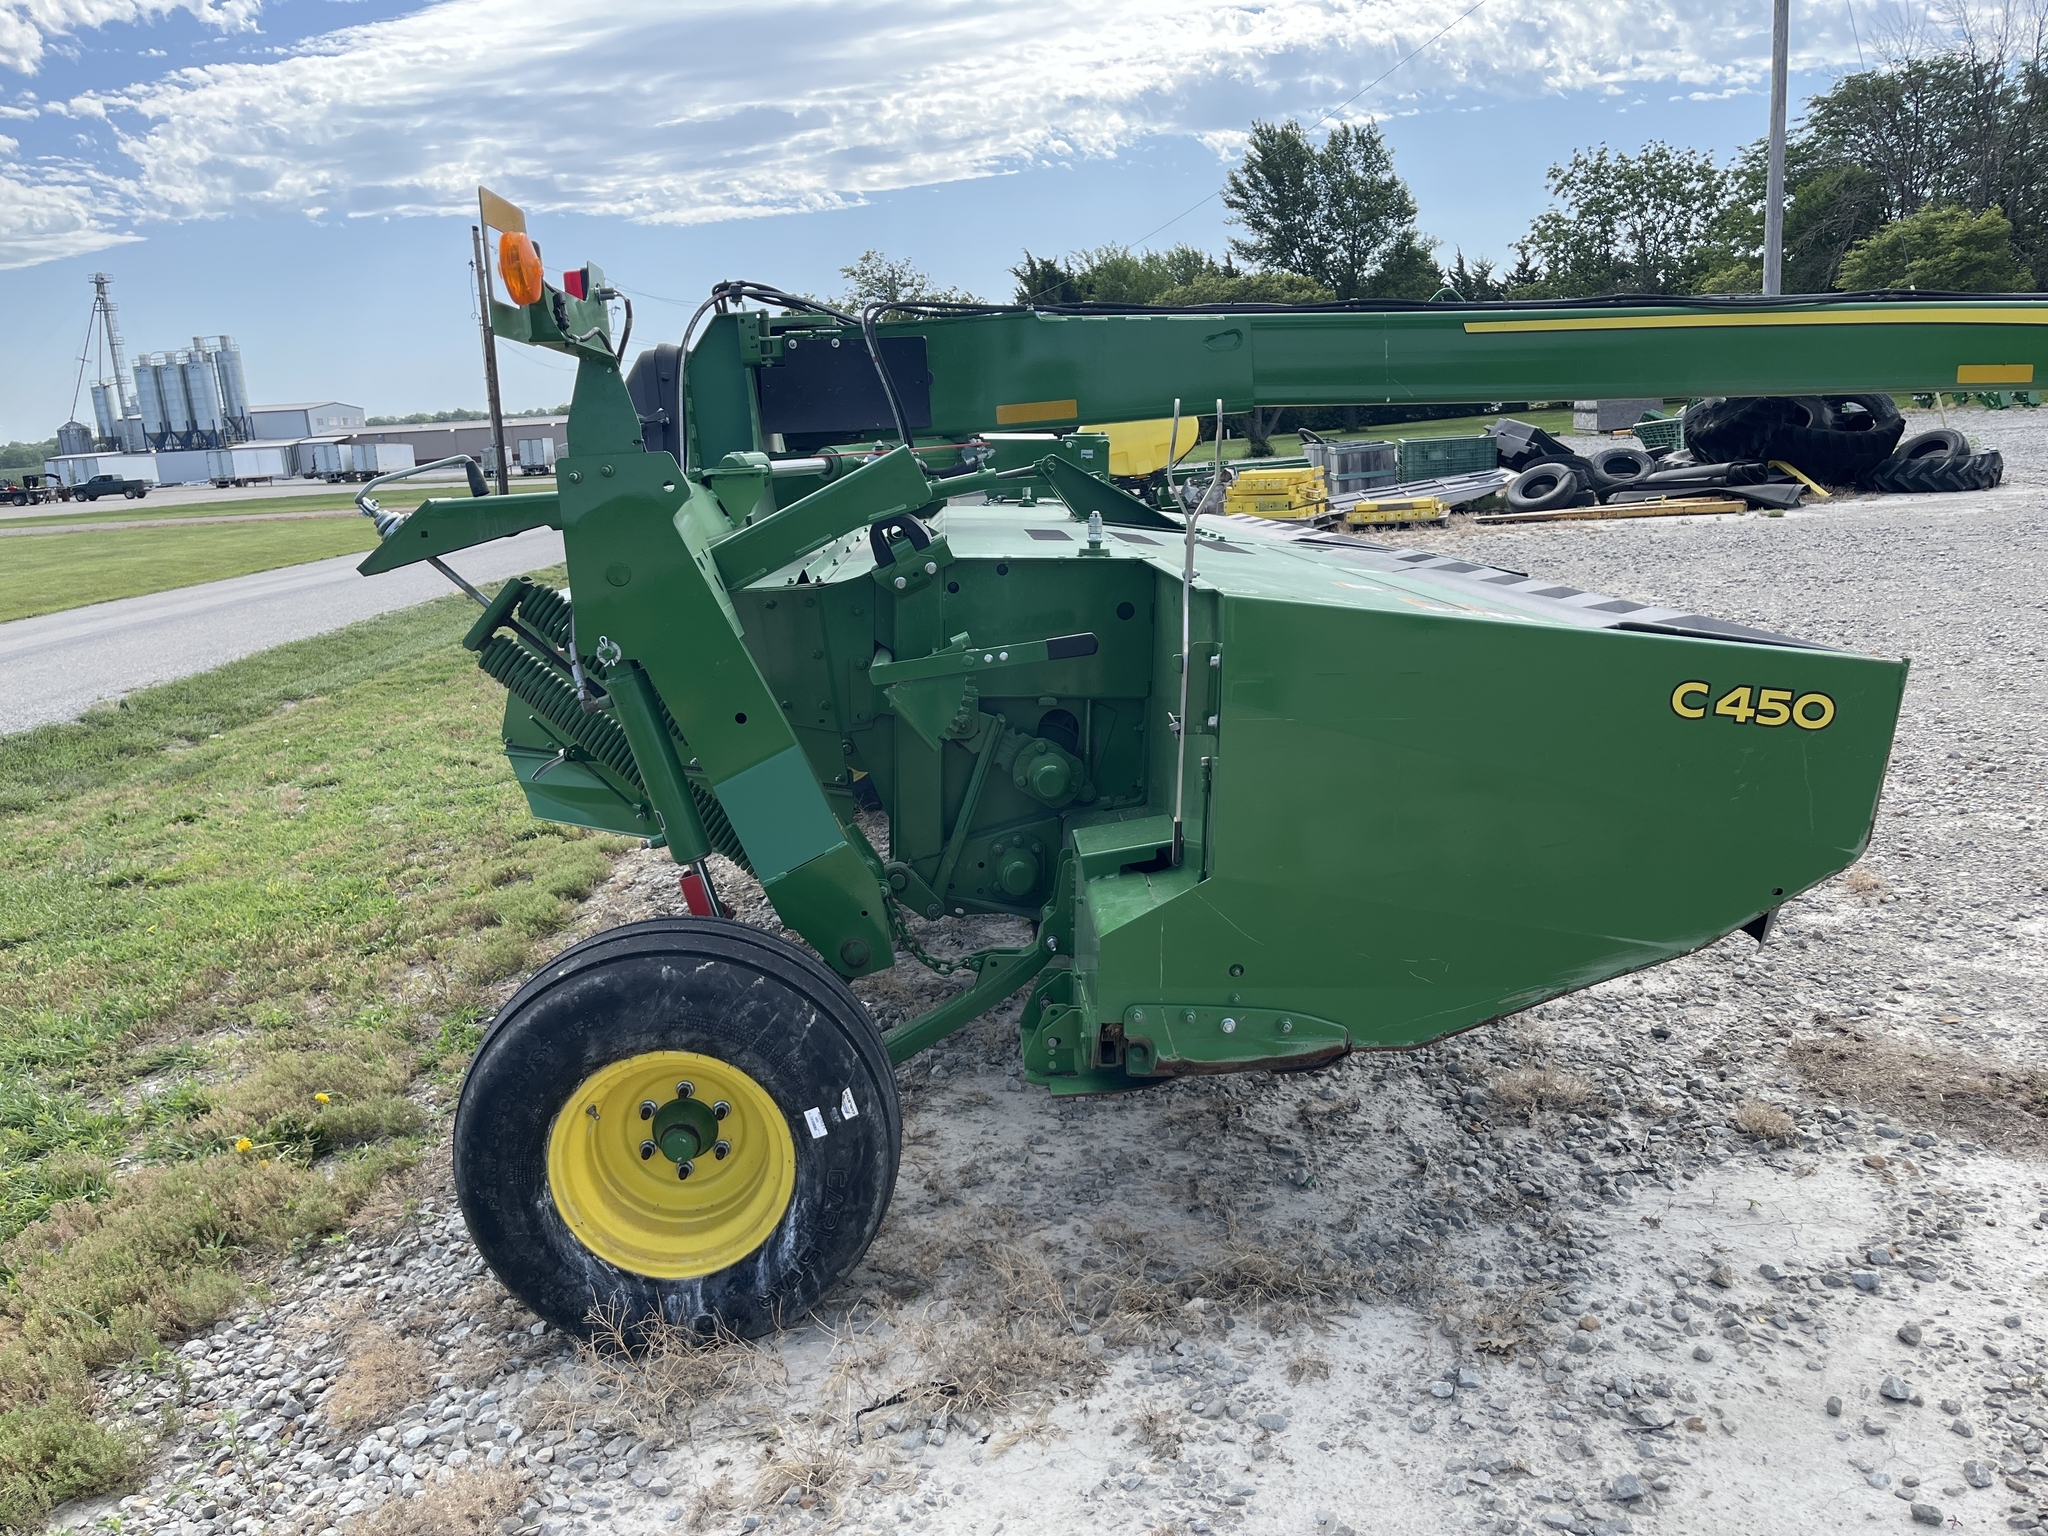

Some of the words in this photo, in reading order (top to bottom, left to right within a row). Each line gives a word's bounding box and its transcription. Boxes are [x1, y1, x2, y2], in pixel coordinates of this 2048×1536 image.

[1670, 679, 1711, 720] C
[1712, 684, 1837, 731] 450
[486, 1039, 555, 1149] SPECIALIST
[483, 1151, 501, 1211] FARM
[757, 1168, 849, 1309] CARLSTAR
